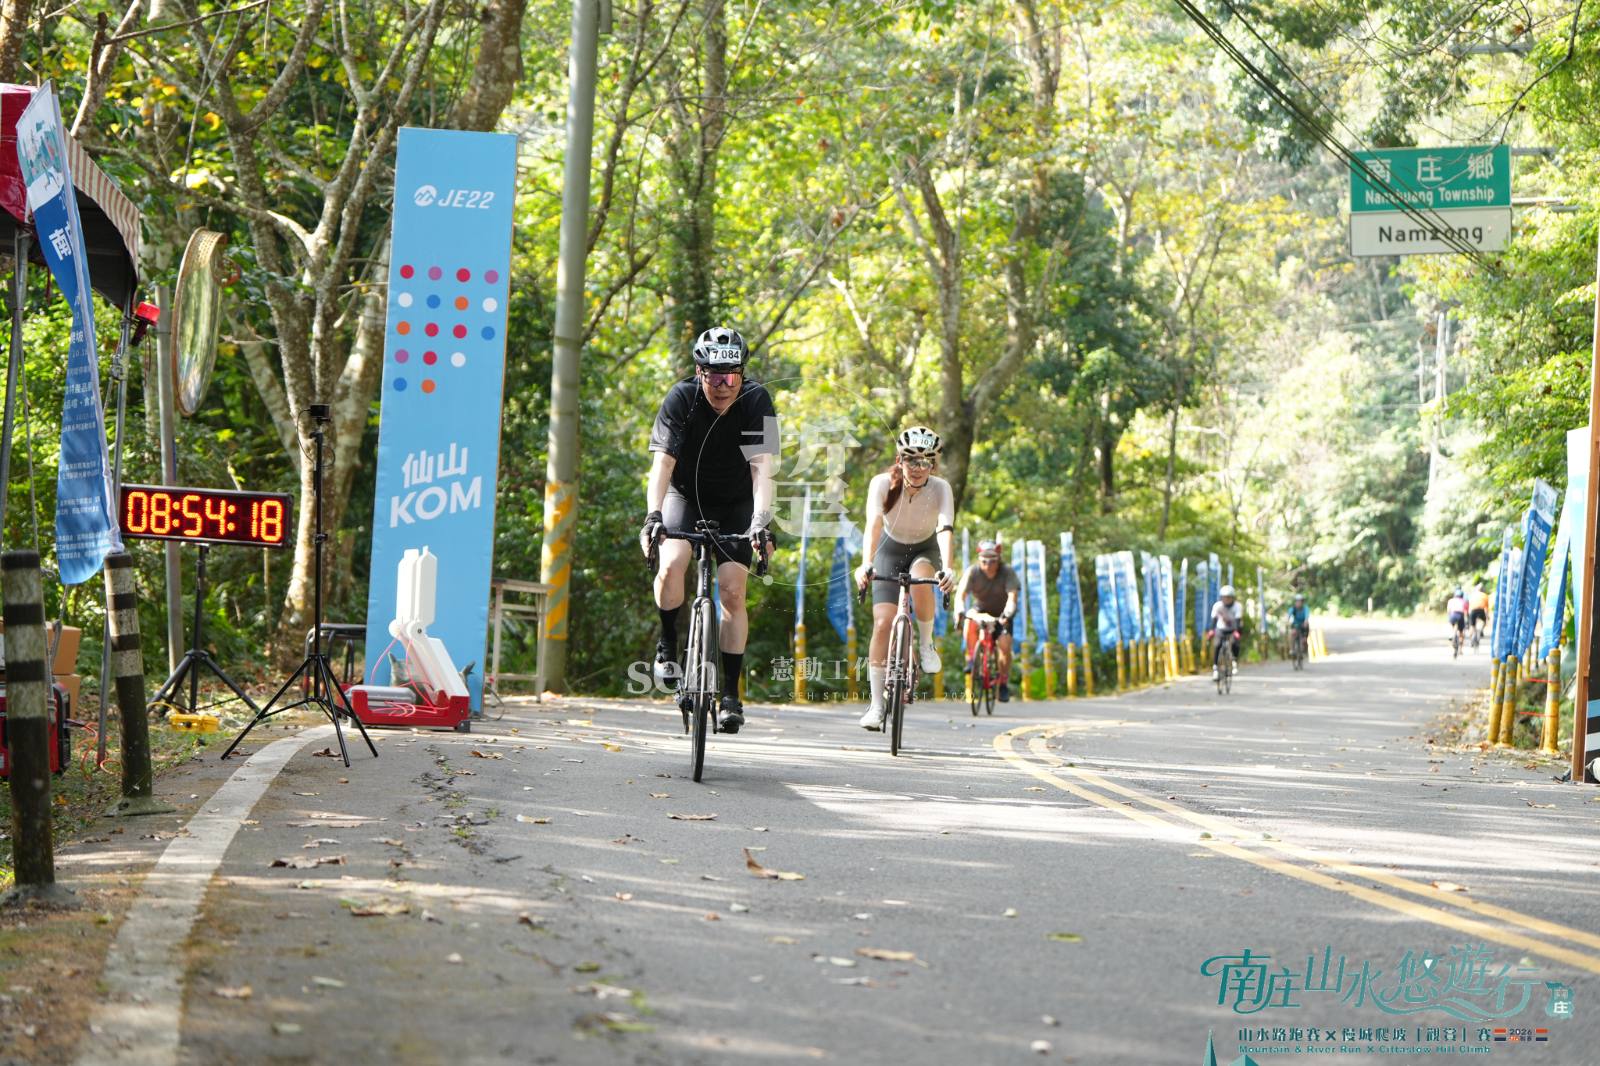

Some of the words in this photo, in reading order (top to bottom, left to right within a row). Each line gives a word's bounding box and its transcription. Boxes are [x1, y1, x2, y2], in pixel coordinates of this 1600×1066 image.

[438, 189, 496, 209] JE22
[1438, 186, 1494, 203] Township
[402, 442, 468, 488] 仙山
[127, 491, 282, 542] 08:54:18
[390, 476, 482, 528] KOM
